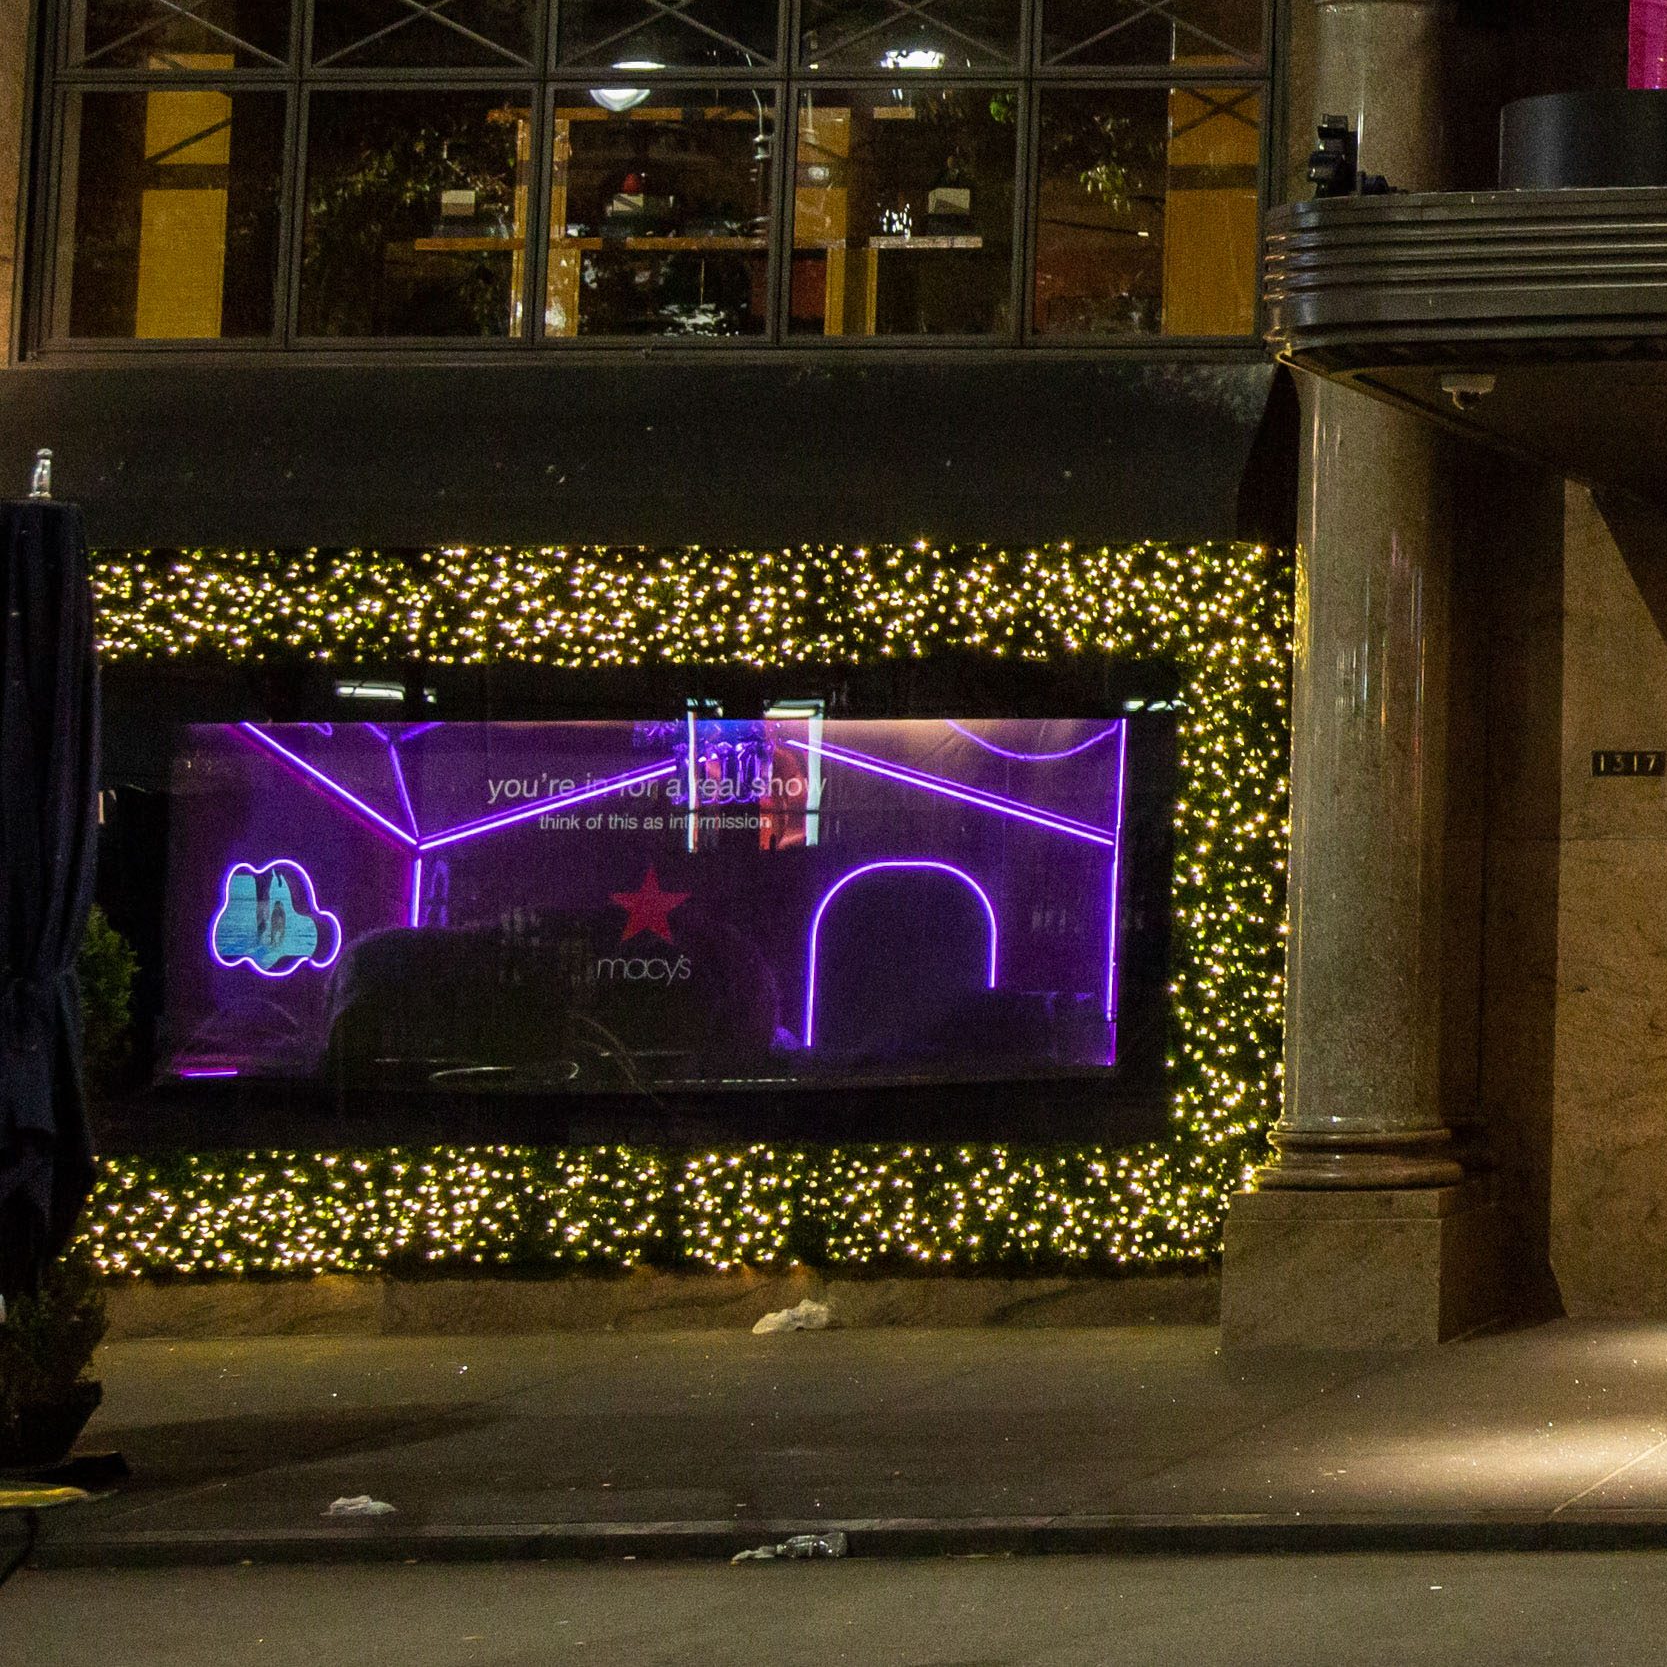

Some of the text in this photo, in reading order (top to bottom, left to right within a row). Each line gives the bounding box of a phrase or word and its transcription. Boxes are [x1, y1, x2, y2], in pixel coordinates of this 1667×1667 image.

[1599, 754, 1658, 773] 1317
[486, 774, 577, 805] you're
[665, 778, 682, 798] a
[539, 813, 772, 830] think of this as intrmission
[596, 954, 692, 986] macy's
